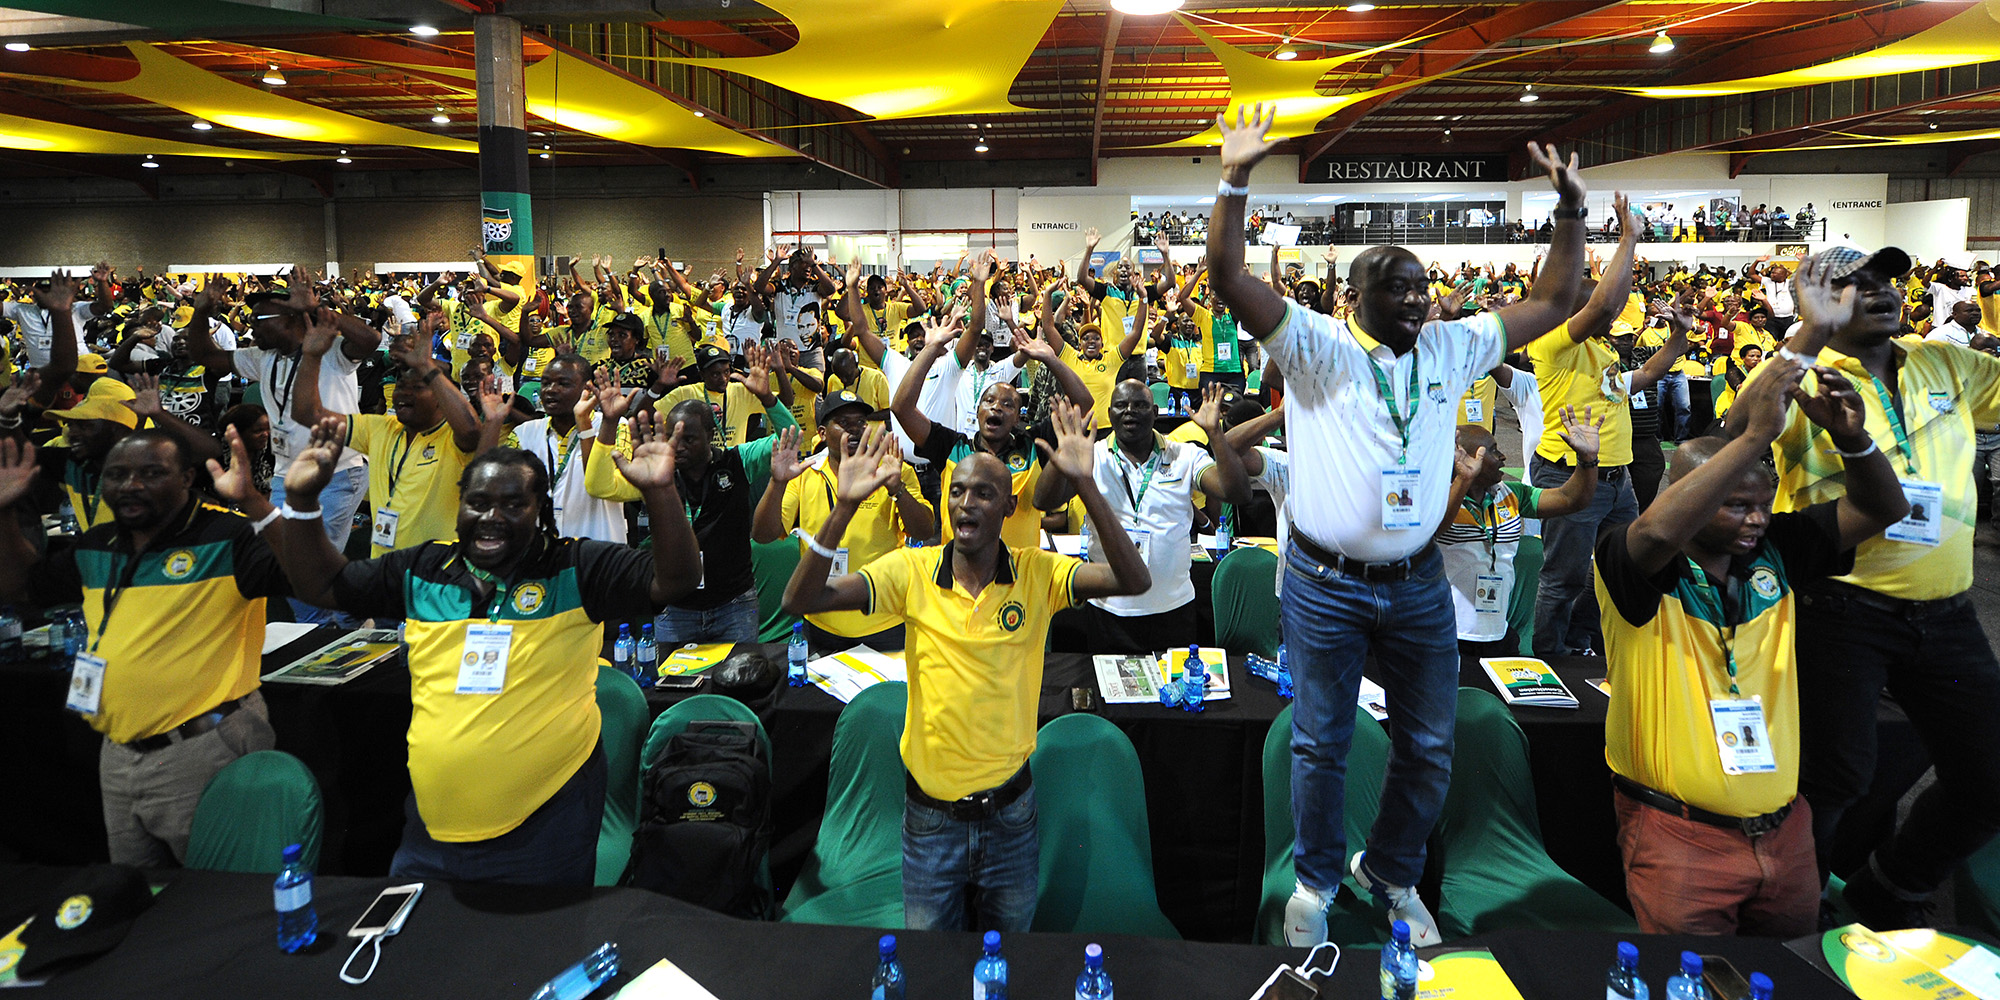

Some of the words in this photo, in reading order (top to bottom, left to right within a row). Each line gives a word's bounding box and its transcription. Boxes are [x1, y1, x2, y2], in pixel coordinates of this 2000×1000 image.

[1328, 161, 1486, 179] RESTAURANT
[1836, 200, 1882, 209] ENTRANCE
[1031, 222, 1074, 230] ENTRANCE
[487, 241, 514, 252] ANC
